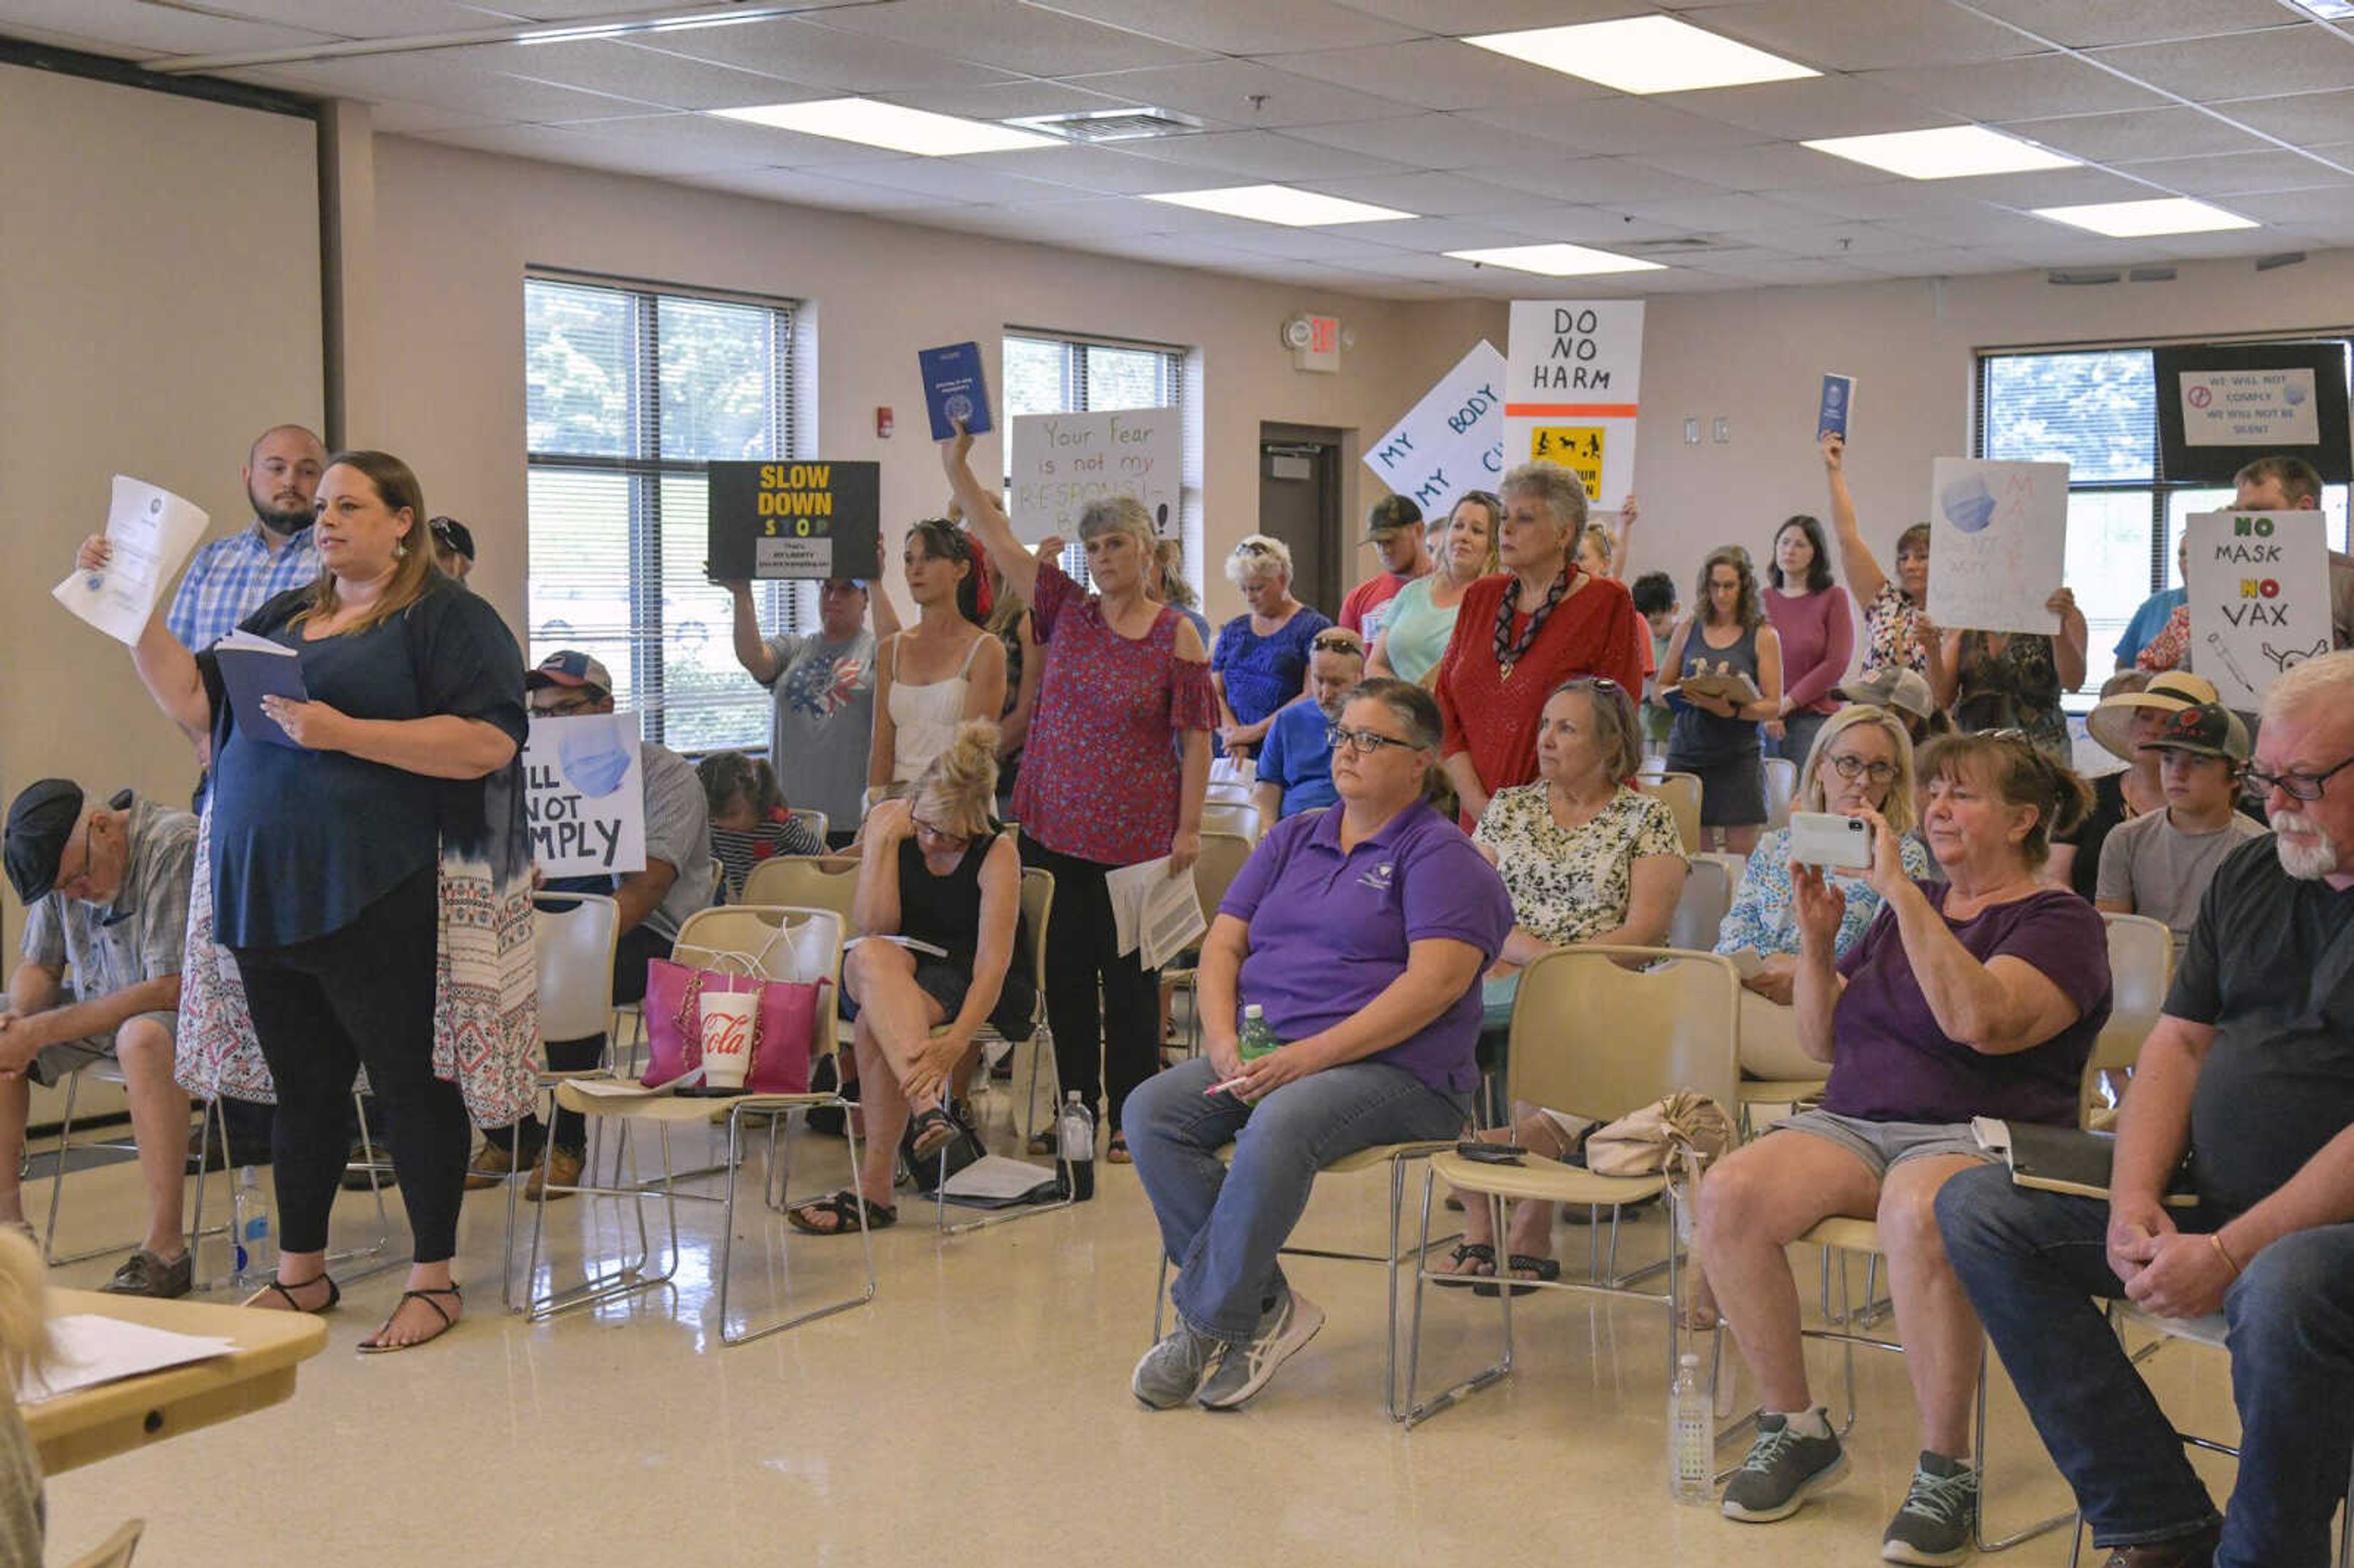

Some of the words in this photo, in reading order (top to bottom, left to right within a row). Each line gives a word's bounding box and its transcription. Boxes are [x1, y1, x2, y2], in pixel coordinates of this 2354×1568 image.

[1555, 308, 1597, 333] DO
[1312, 317, 1335, 353] EXIT
[1551, 337, 1597, 360] NO
[1534, 365, 1610, 389] HARM
[2226, 392, 2271, 401] COMPLY
[1045, 420, 1095, 448] Your
[1110, 417, 1154, 444] Fear
[1378, 432, 1413, 468] MY
[1448, 383, 1498, 434] BODY
[760, 464, 830, 489] SLOW
[1038, 459, 1056, 474] is
[1073, 452, 1105, 471] not
[1120, 456, 1154, 477] my
[1415, 468, 1450, 507] MY
[758, 492, 832, 516] DOWN
[2234, 517, 2274, 537] NO
[2214, 543, 2282, 563] MASK
[2241, 577, 2280, 599] NO
[2222, 603, 2288, 627] VAX
[522, 765, 560, 790] ILL
[526, 795, 582, 821] NOT
[529, 819, 622, 867] MPLY
